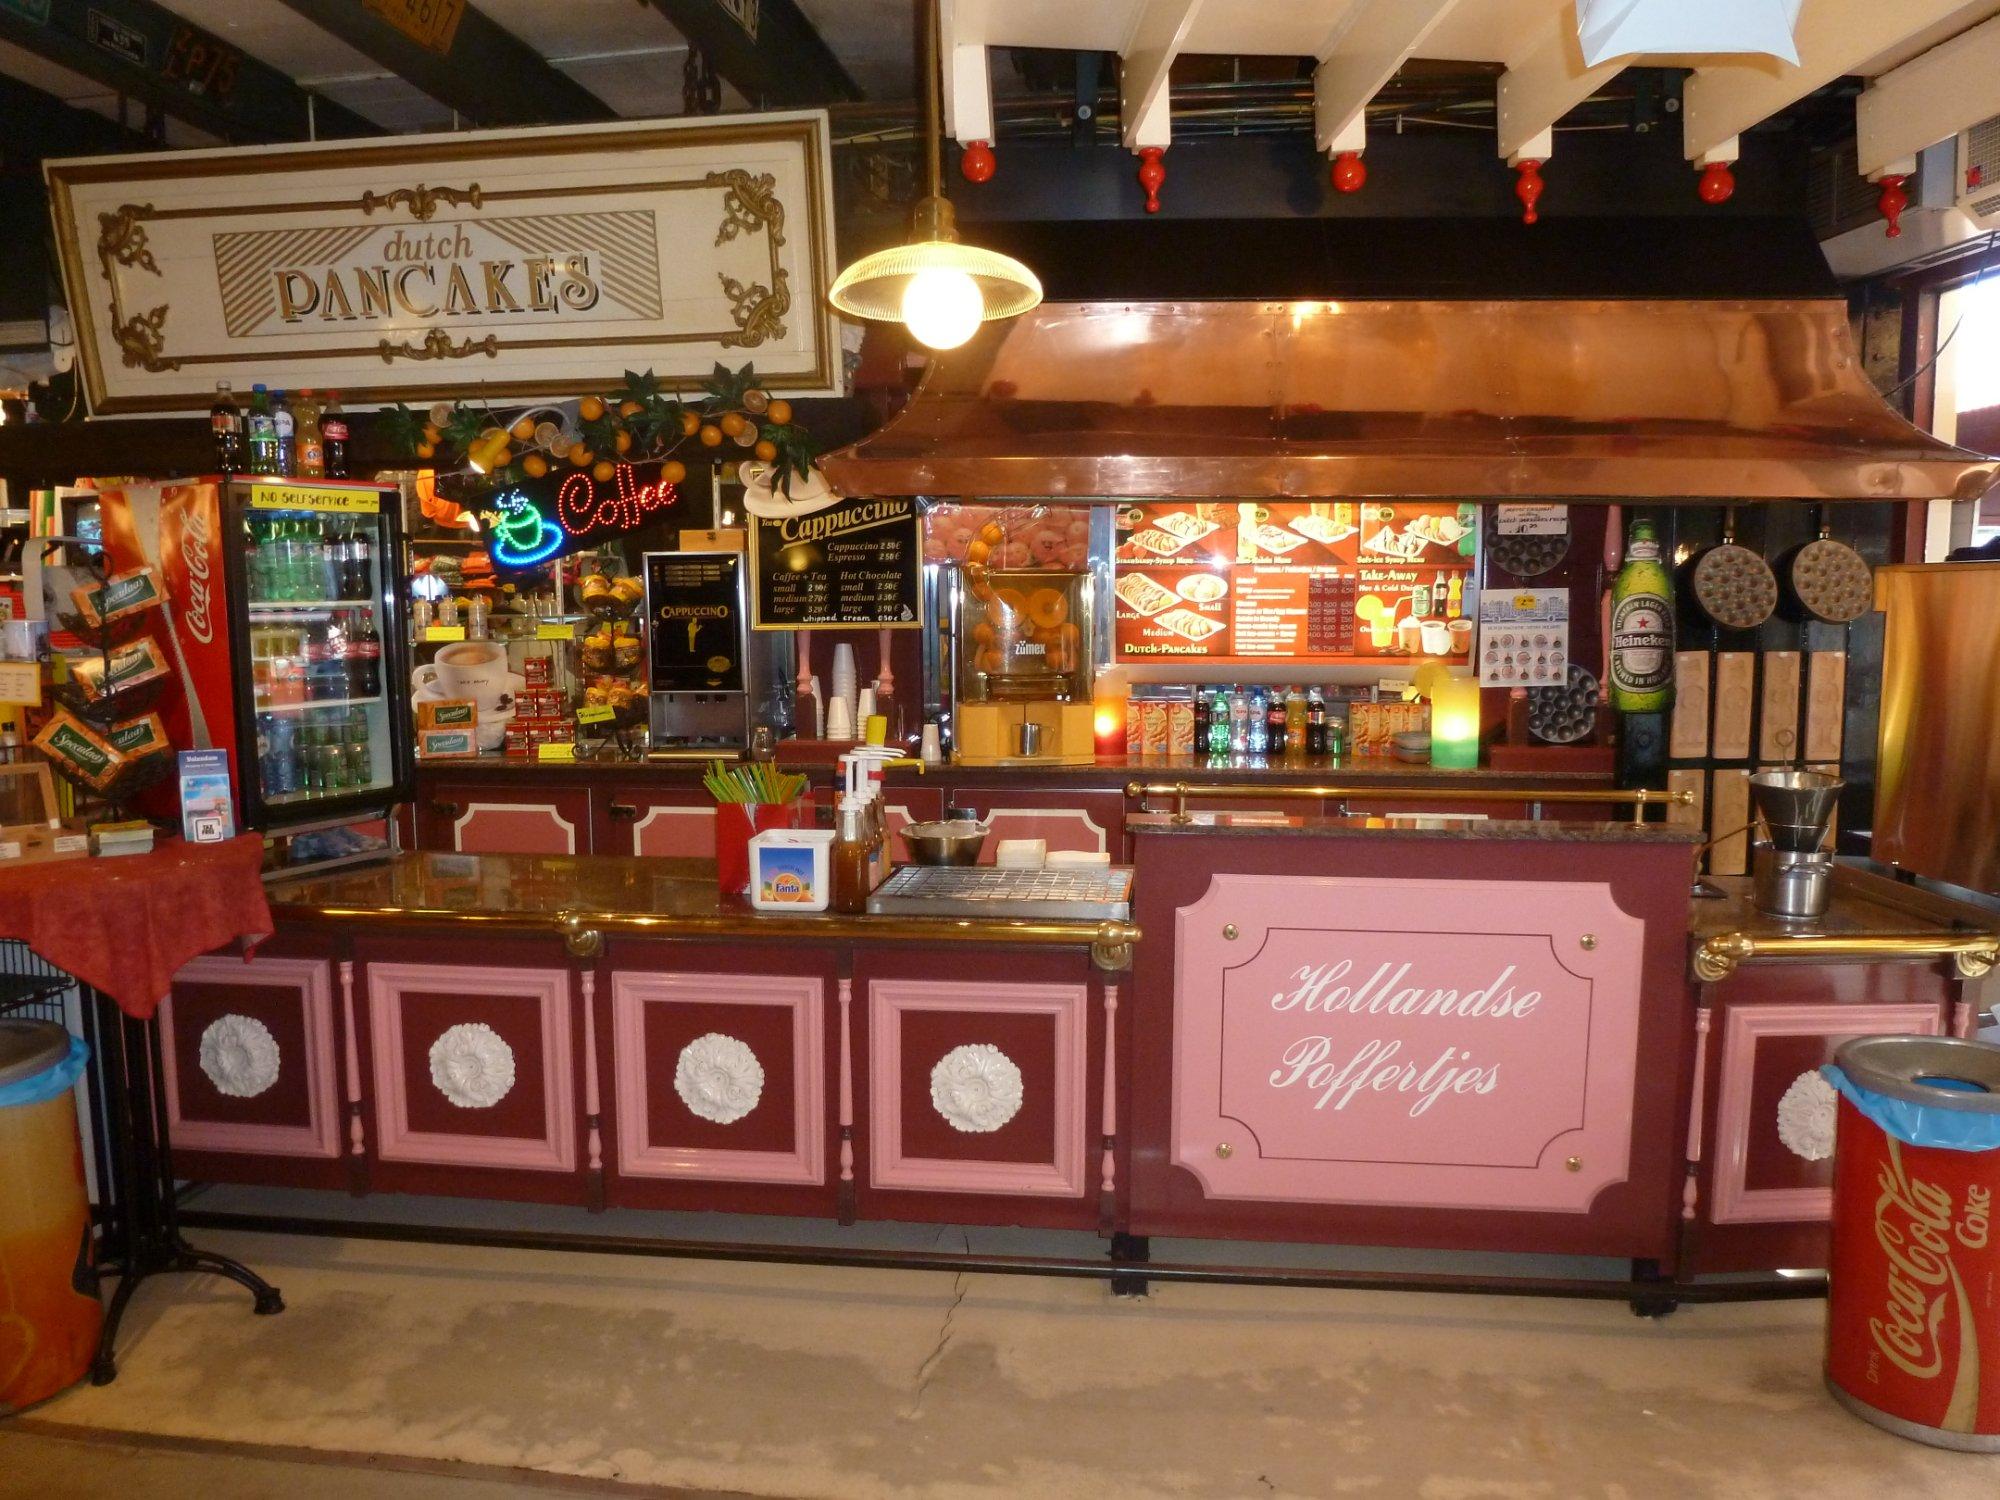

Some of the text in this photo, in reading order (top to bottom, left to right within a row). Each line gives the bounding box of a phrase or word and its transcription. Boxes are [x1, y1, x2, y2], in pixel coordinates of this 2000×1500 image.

[383, 224, 474, 262] dutch
[273, 254, 600, 324] PANCAKES
[261, 491, 277, 503] NO
[558, 464, 678, 535] Coffee
[780, 501, 909, 541] Cappuccino
[827, 542, 879, 553] Cappuccino
[827, 553, 867, 563] Espresso
[181, 506, 213, 644] Coca-Cola
[772, 571, 801, 583] Coffee
[811, 572, 828, 581] Tea
[840, 570, 902, 580] Hot Chocolate
[773, 583, 797, 592] small
[840, 582, 864, 591] small
[1382, 584, 1399, 592] Cold
[773, 594, 807, 603] medium
[840, 593, 875, 602] medium
[661, 604, 729, 619] CAPPUCCINO
[773, 605, 796, 615] large
[840, 604, 863, 614] large
[803, 613, 838, 623] whipped
[1615, 634, 1672, 648] Heineken
[437, 706, 469, 724] Speculaas
[430, 734, 466, 750] Speculaas
[53, 733, 106, 765] Speculaas
[775, 883, 800, 894] Fanta
[1270, 959, 1542, 1018] Hollandse
[1268, 1035, 1501, 1118] Poffertjes
[1955, 1183, 1991, 1249] Coke
[1869, 1158, 1953, 1379] Coca-Cola
